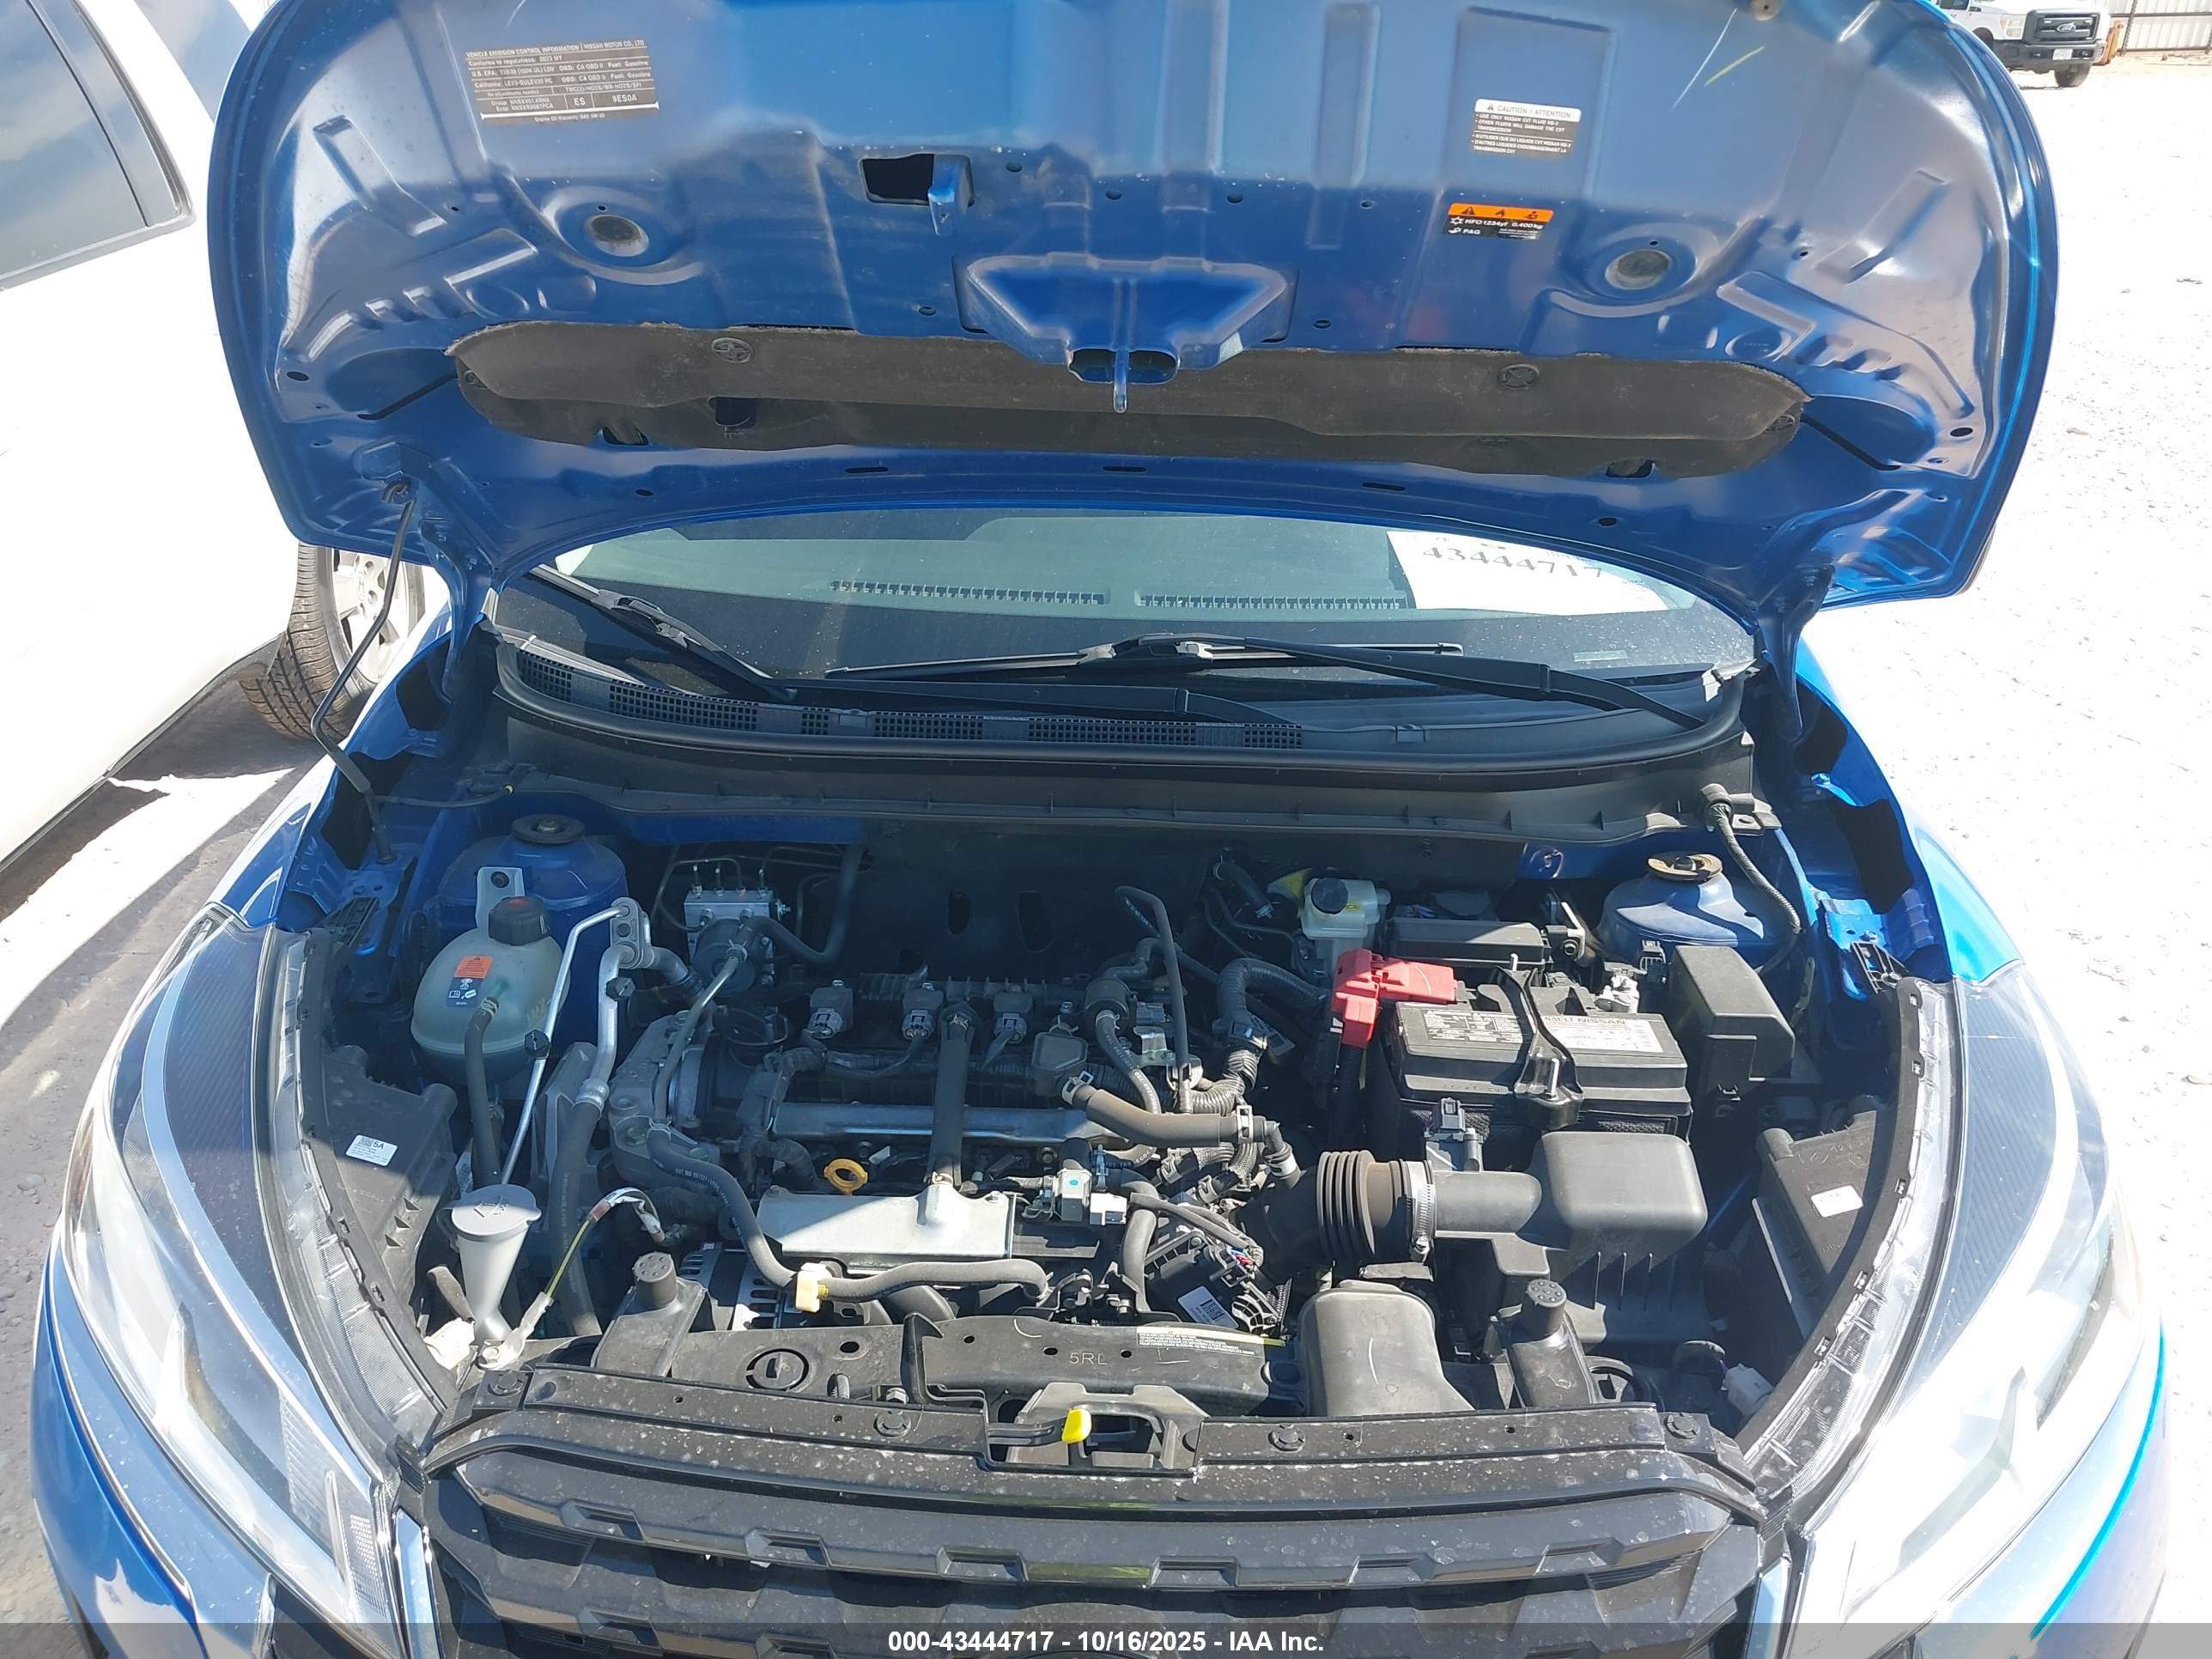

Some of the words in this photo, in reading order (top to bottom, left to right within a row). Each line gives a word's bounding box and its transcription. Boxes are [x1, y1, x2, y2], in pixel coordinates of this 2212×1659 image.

[574, 96, 586, 106] ES
[1498, 105, 1527, 114] CAUTION
[1534, 109, 1571, 118] ATTENTION
[1423, 546, 1601, 578] 43444717
[1070, 1352, 1107, 1365] 5RL
